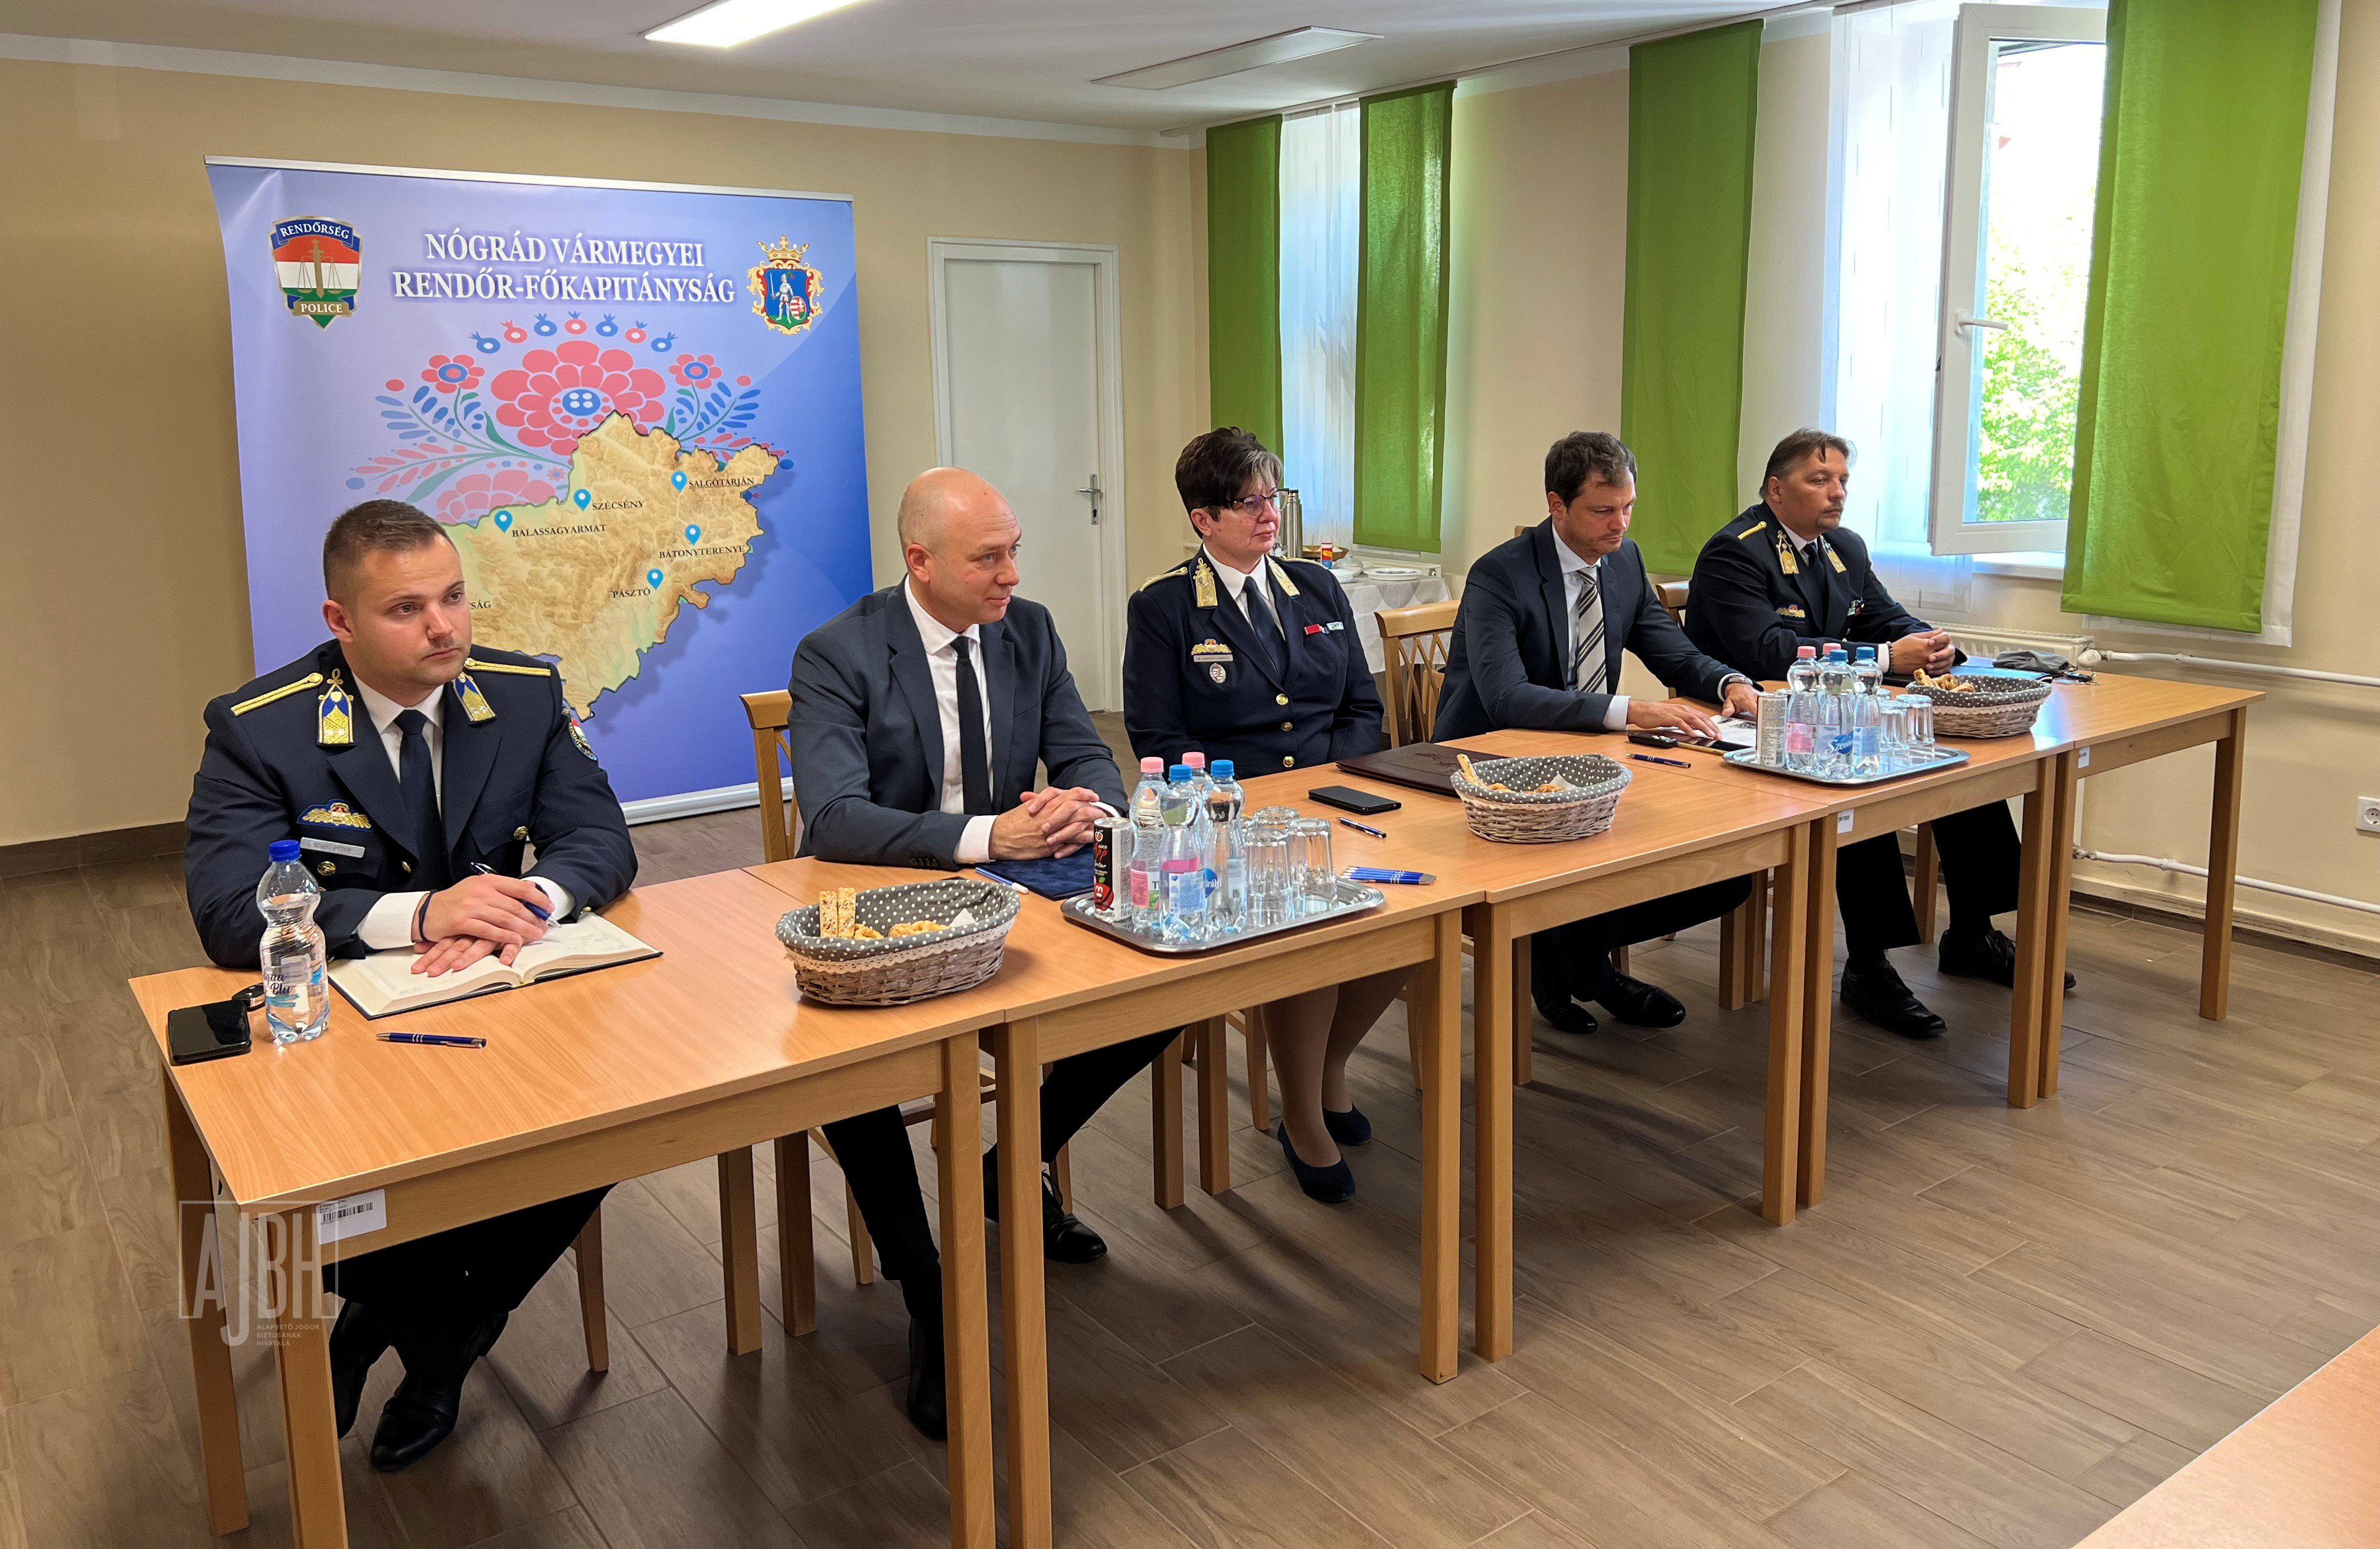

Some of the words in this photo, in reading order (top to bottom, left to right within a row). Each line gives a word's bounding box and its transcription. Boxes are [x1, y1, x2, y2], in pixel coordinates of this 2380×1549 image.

[280, 222, 349, 239] RENDŐRSÉG
[424, 227, 547, 262] NÓGRÁD
[551, 233, 705, 267] VÁRMEGYEI
[392, 266, 736, 303] RENDŐR-FŐKAPITÁNYSÁG
[300, 302, 343, 313] POLICE
[689, 476, 754, 487] SALGÓTARJÁN
[592, 499, 645, 511] SZÉCSÉNY
[512, 524, 607, 538] BALASSAGYARMAT
[659, 545, 746, 558] BÁTONYTERENYE
[612, 587, 651, 599] PÁSZTÓ
[468, 599, 491, 610] SÁG
[1205, 878, 1222, 890] irályi
